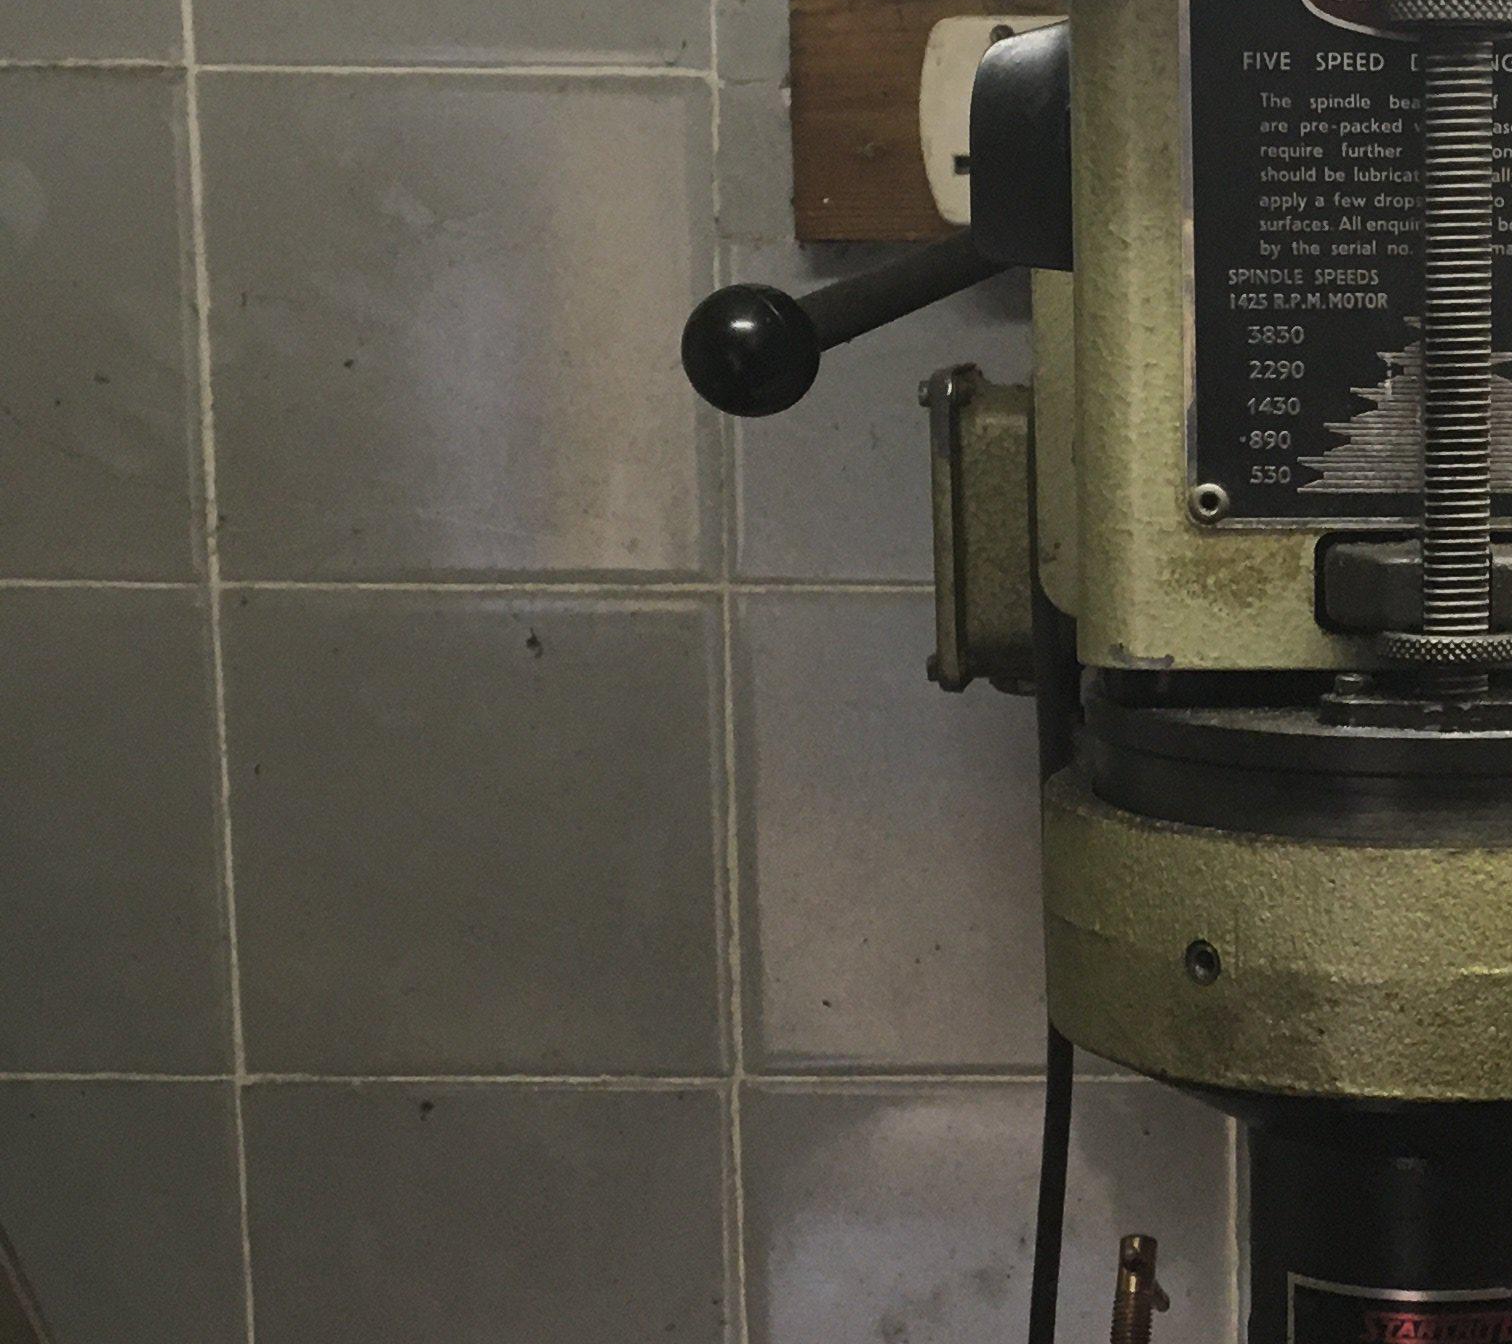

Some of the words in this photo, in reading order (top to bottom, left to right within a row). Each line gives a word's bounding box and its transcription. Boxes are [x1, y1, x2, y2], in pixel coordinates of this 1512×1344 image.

[1243, 52, 1291, 71] FIVE
[1316, 52, 1384, 71] SPEED
[1260, 92, 1292, 108] The
[1310, 94, 1371, 113] spindle
[1260, 120, 1288, 133] are
[1300, 118, 1402, 136] pre-packed
[1260, 144, 1324, 161] require
[1341, 142, 1403, 158] further
[1260, 167, 1316, 182] should
[1324, 167, 1345, 182] be
[1353, 167, 1420, 182] lubricat
[1259, 192, 1307, 212] apply
[1315, 196, 1325, 207] a
[1334, 192, 1366, 207] few
[1259, 216, 1334, 232] surfaces.
[1338, 216, 1361, 231] All
[1366, 217, 1421, 236] enquir
[1259, 240, 1281, 259] by
[1292, 241, 1320, 256] the
[1331, 241, 1377, 256] serial
[1387, 243, 1413, 256] no.
[1228, 268, 1303, 285] SPINDLE
[1314, 268, 1379, 285] SPEEDS
[1229, 293, 1268, 309] 1425
[1328, 293, 1389, 309] MOTOR
[1247, 325, 1305, 344] 3830
[1250, 360, 1305, 380] 2290
[1248, 397, 1300, 415] 1430
[1249, 430, 1292, 449] 890
[1251, 466, 1291, 484] 530
